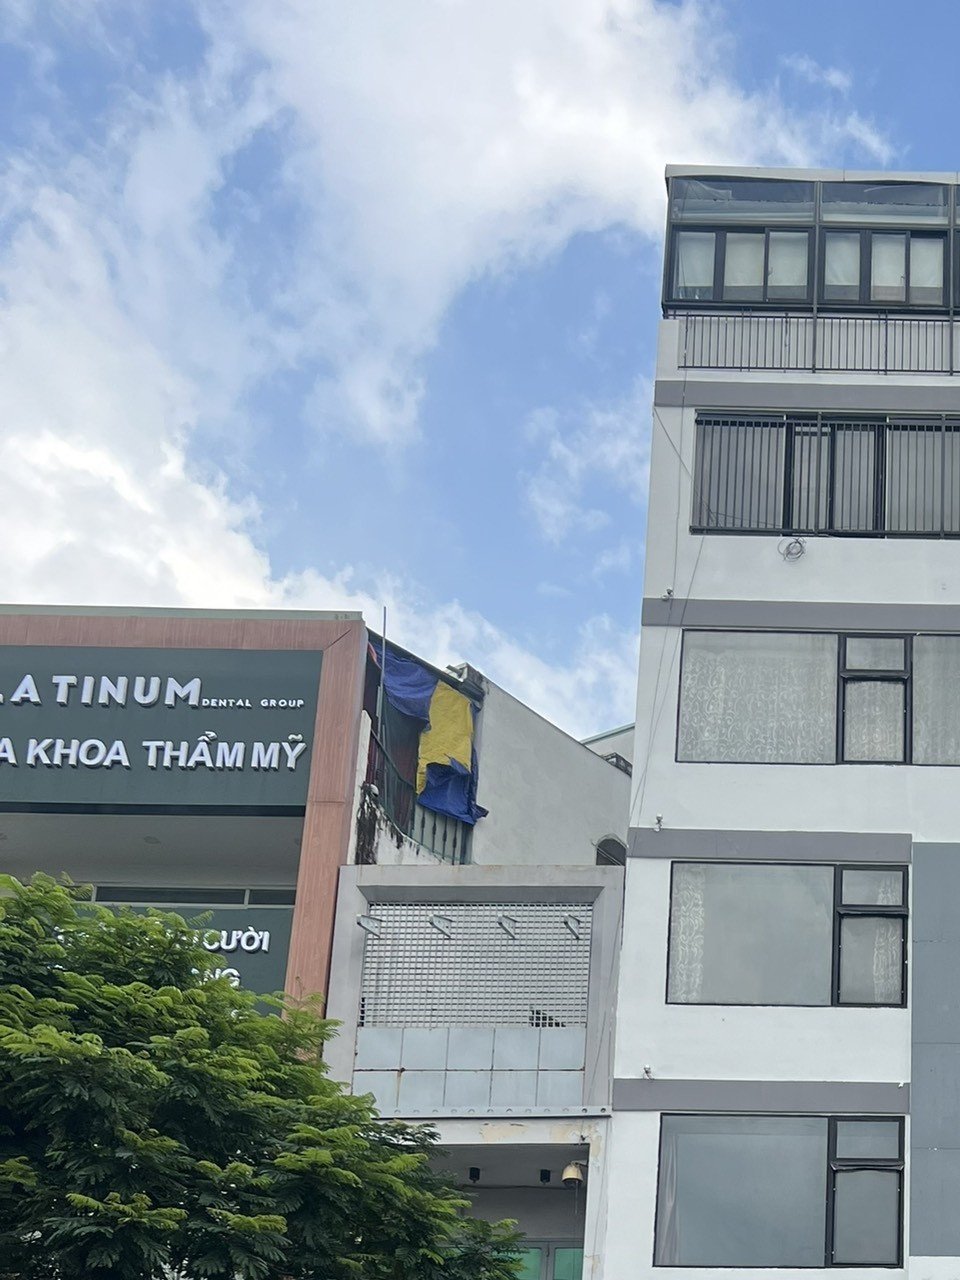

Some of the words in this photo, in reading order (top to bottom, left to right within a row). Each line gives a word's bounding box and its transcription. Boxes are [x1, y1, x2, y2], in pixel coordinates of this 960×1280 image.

[0, 674, 201, 705] ATINUM
[202, 698, 252, 708] DENTAL
[260, 699, 304, 708] GROUP
[26, 738, 131, 768] KHOA
[142, 731, 245, 769] THẨM
[251, 733, 306, 770] MỸ
